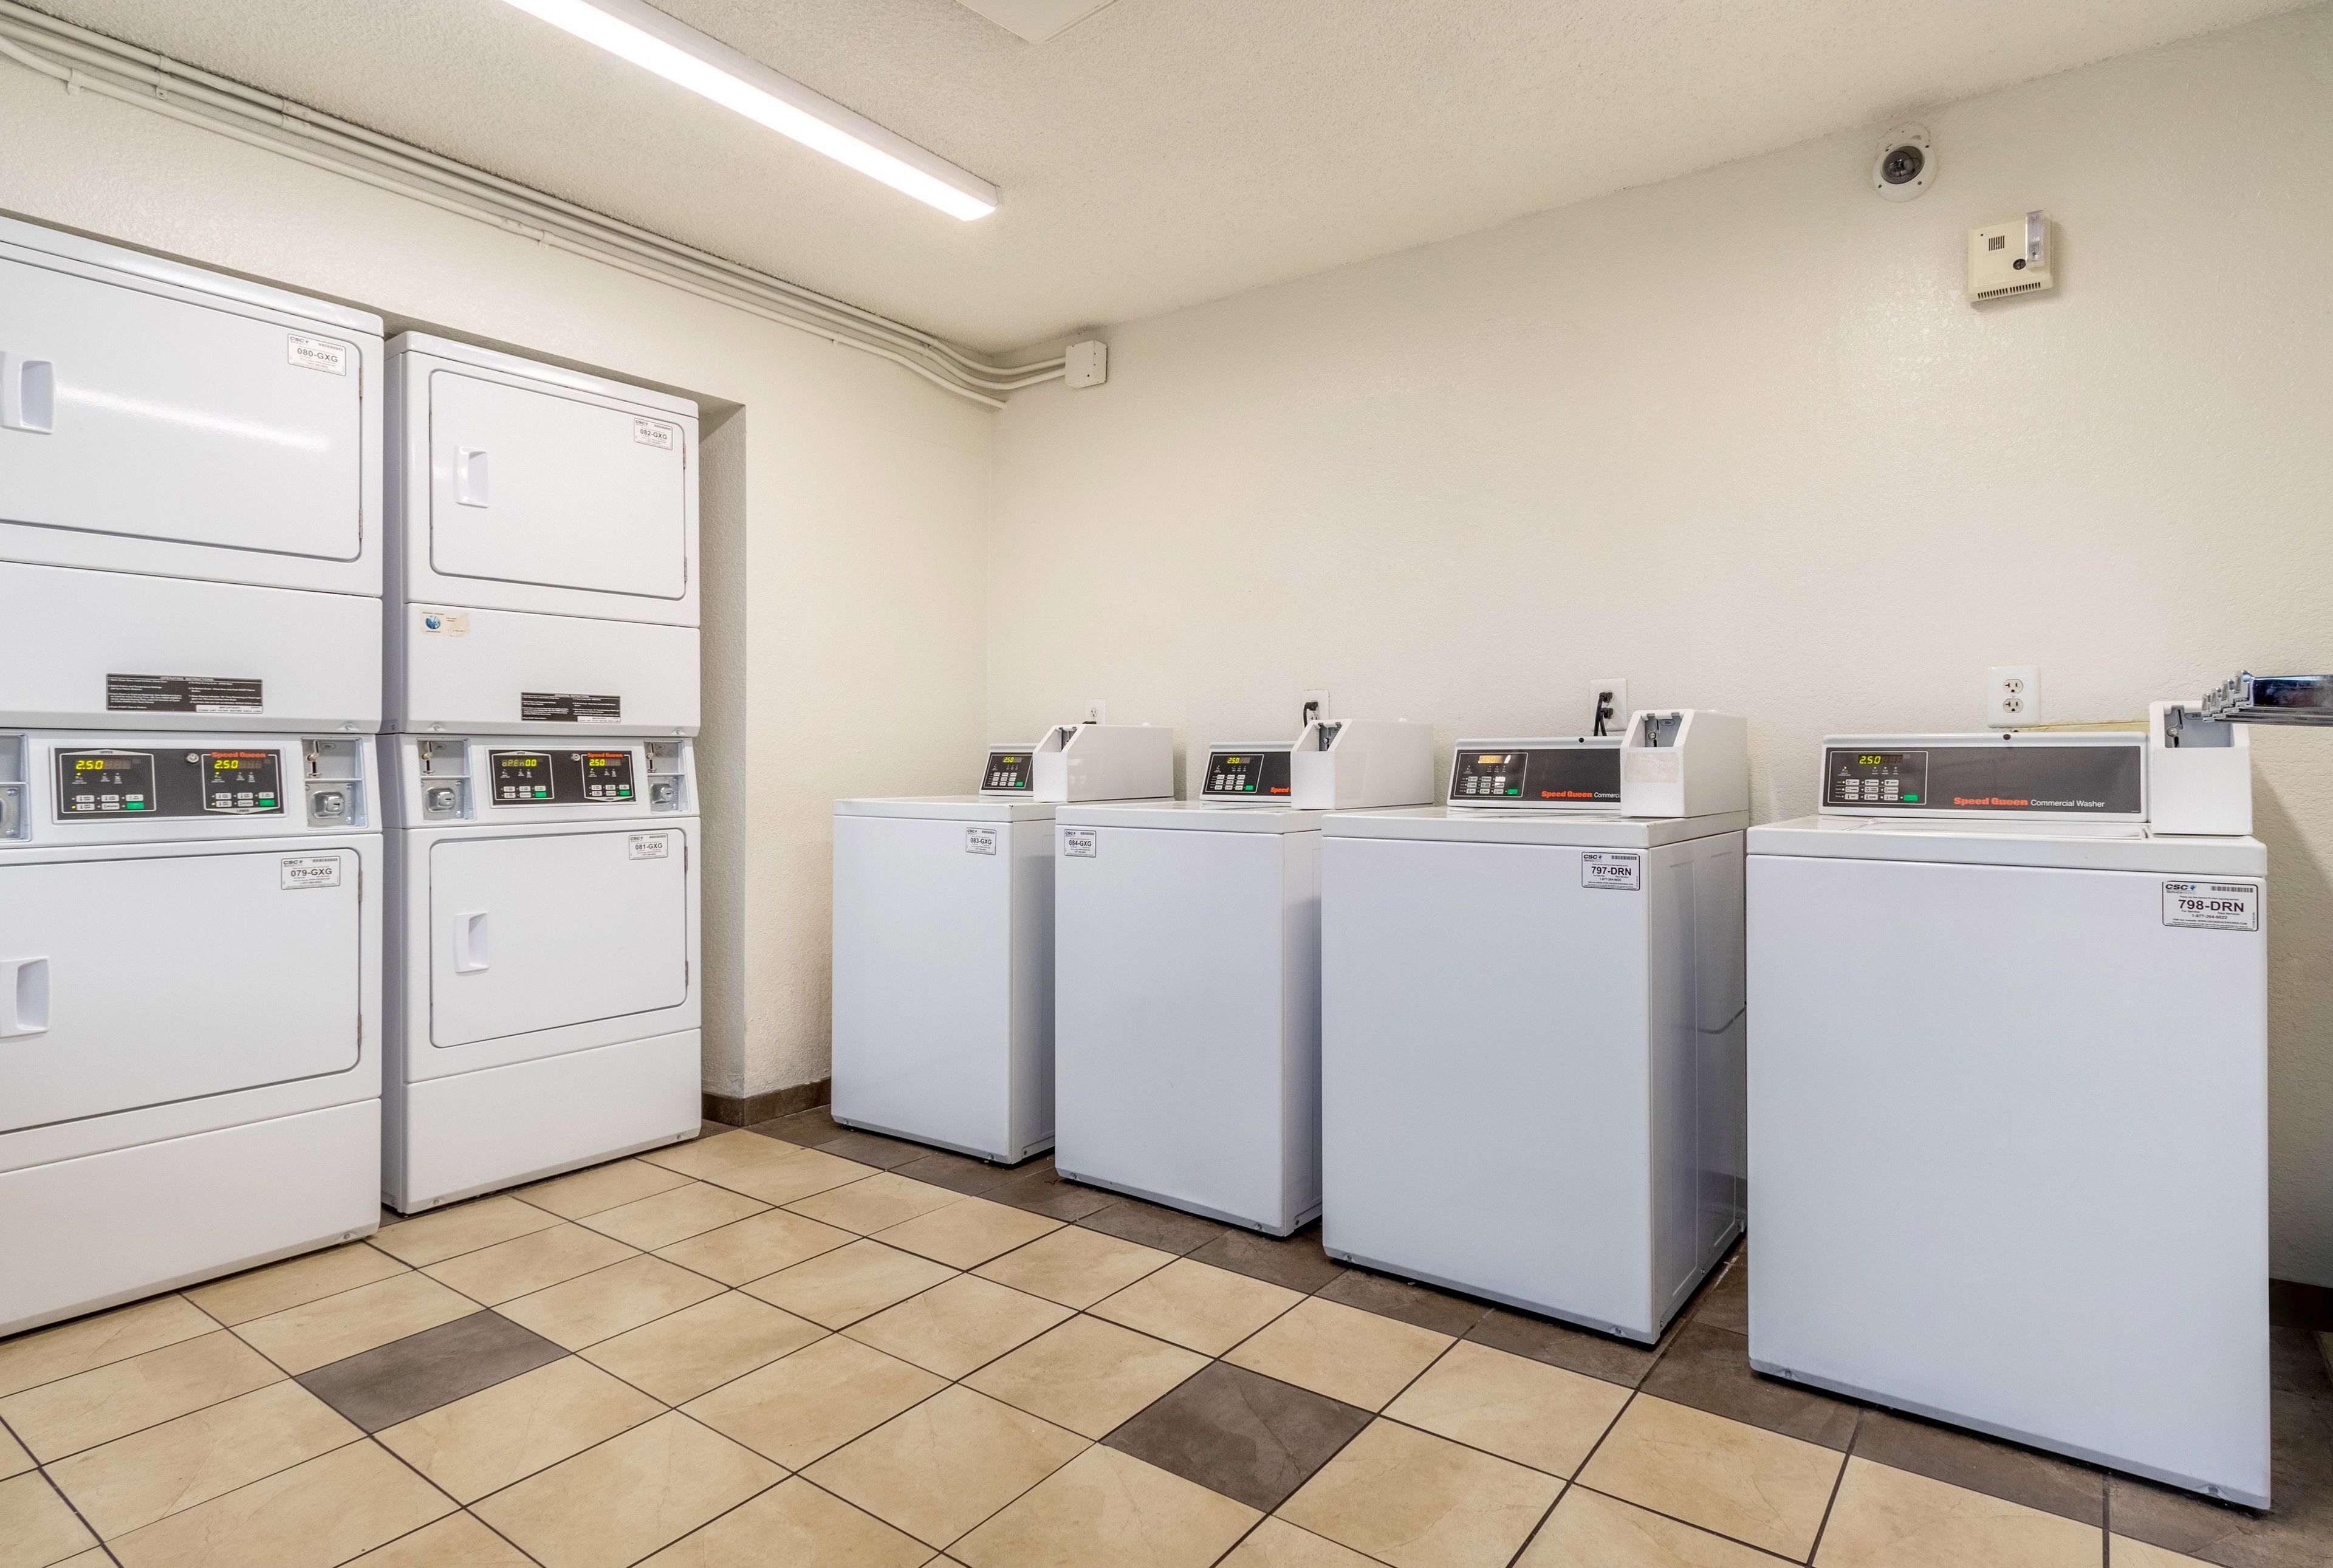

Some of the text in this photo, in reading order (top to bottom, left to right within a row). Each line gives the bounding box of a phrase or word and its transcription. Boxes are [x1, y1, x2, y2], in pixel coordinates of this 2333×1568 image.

[297, 347, 338, 363] 080-GXG
[640, 429, 668, 440] 082-GXG
[75, 760, 104, 770] 2.50
[214, 759, 239, 769] 2.50
[1859, 756, 1882, 764] 2.50
[1953, 797, 1990, 806] Speed
[1991, 797, 2029, 806] Queen
[290, 868, 332, 877] 079-GXG
[1591, 866, 1632, 876] 797-DRN
[2178, 899, 2244, 912] 798-DRN
